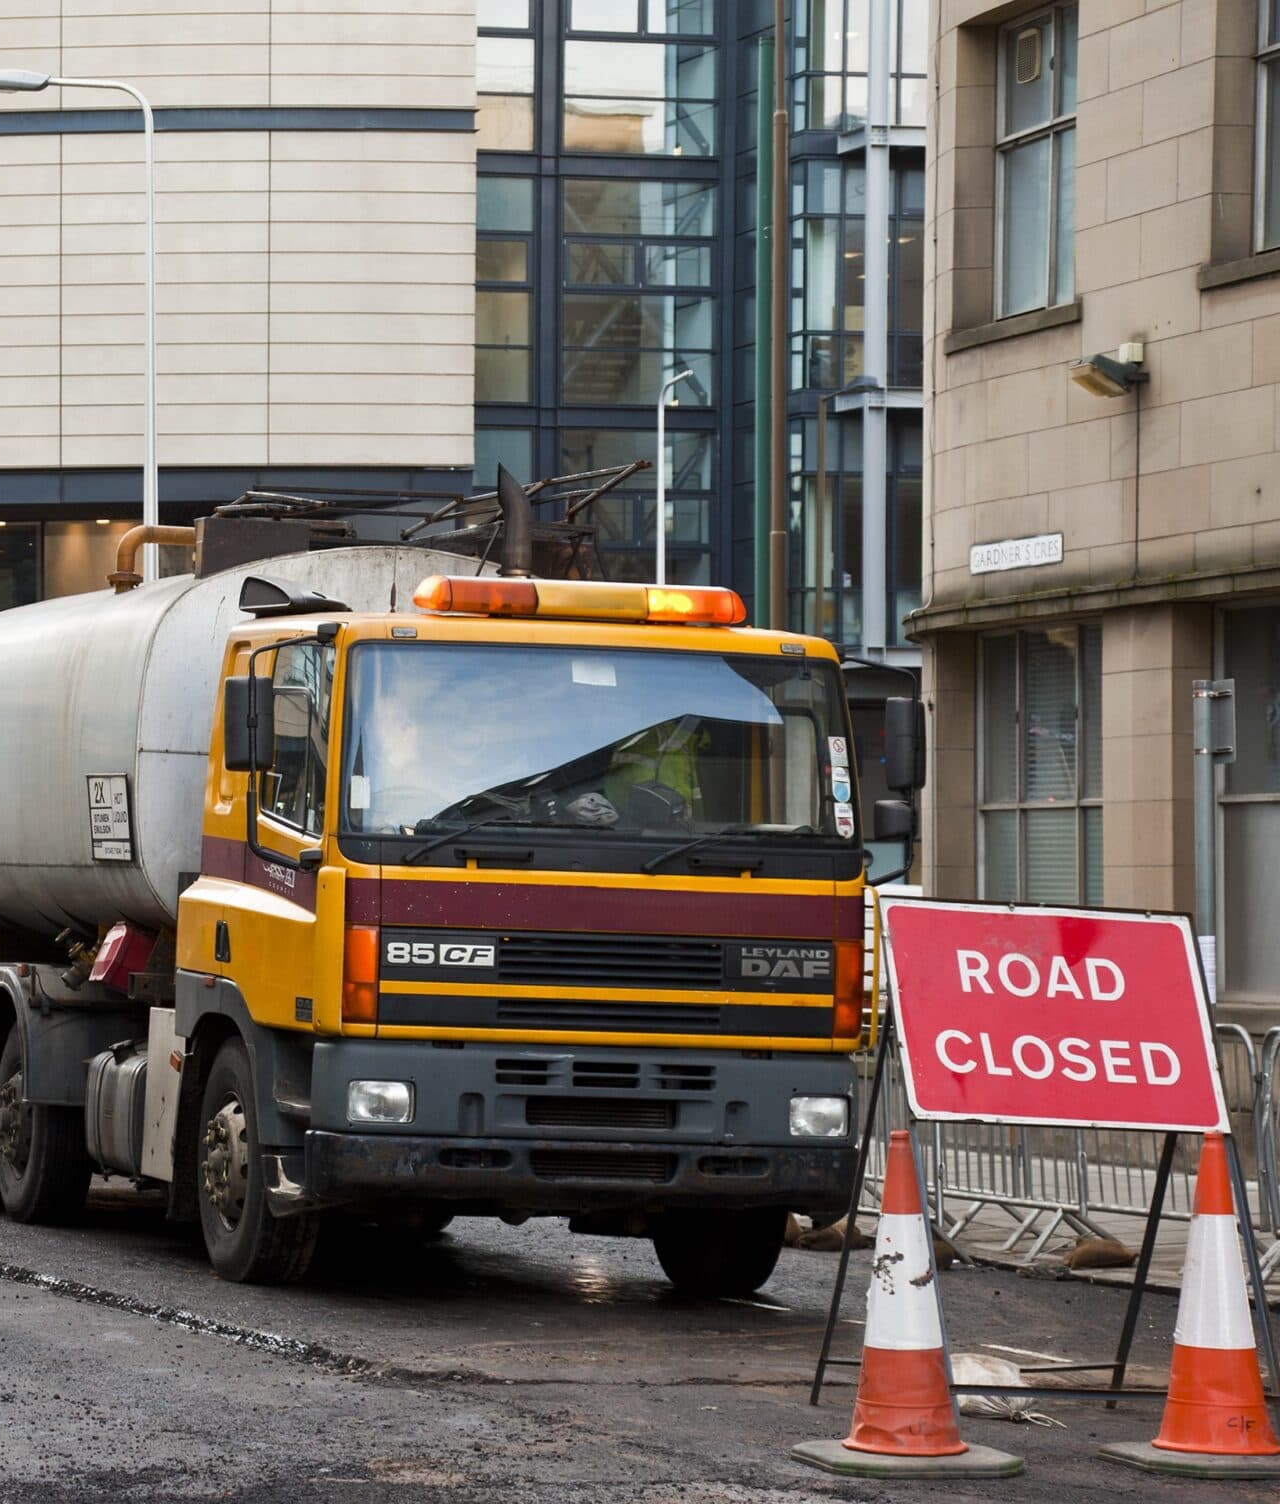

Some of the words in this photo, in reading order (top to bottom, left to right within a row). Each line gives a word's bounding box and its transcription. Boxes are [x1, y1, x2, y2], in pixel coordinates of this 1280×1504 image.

[1034, 540, 1059, 560] CRES
[94, 781, 106, 804] 2X
[387, 942, 436, 965] 85
[442, 945, 493, 965] CF
[741, 947, 830, 959] LEYLAND
[741, 958, 830, 978] DAF
[956, 949, 1125, 1001] ROAD
[935, 1029, 1181, 1086] CLOSED
